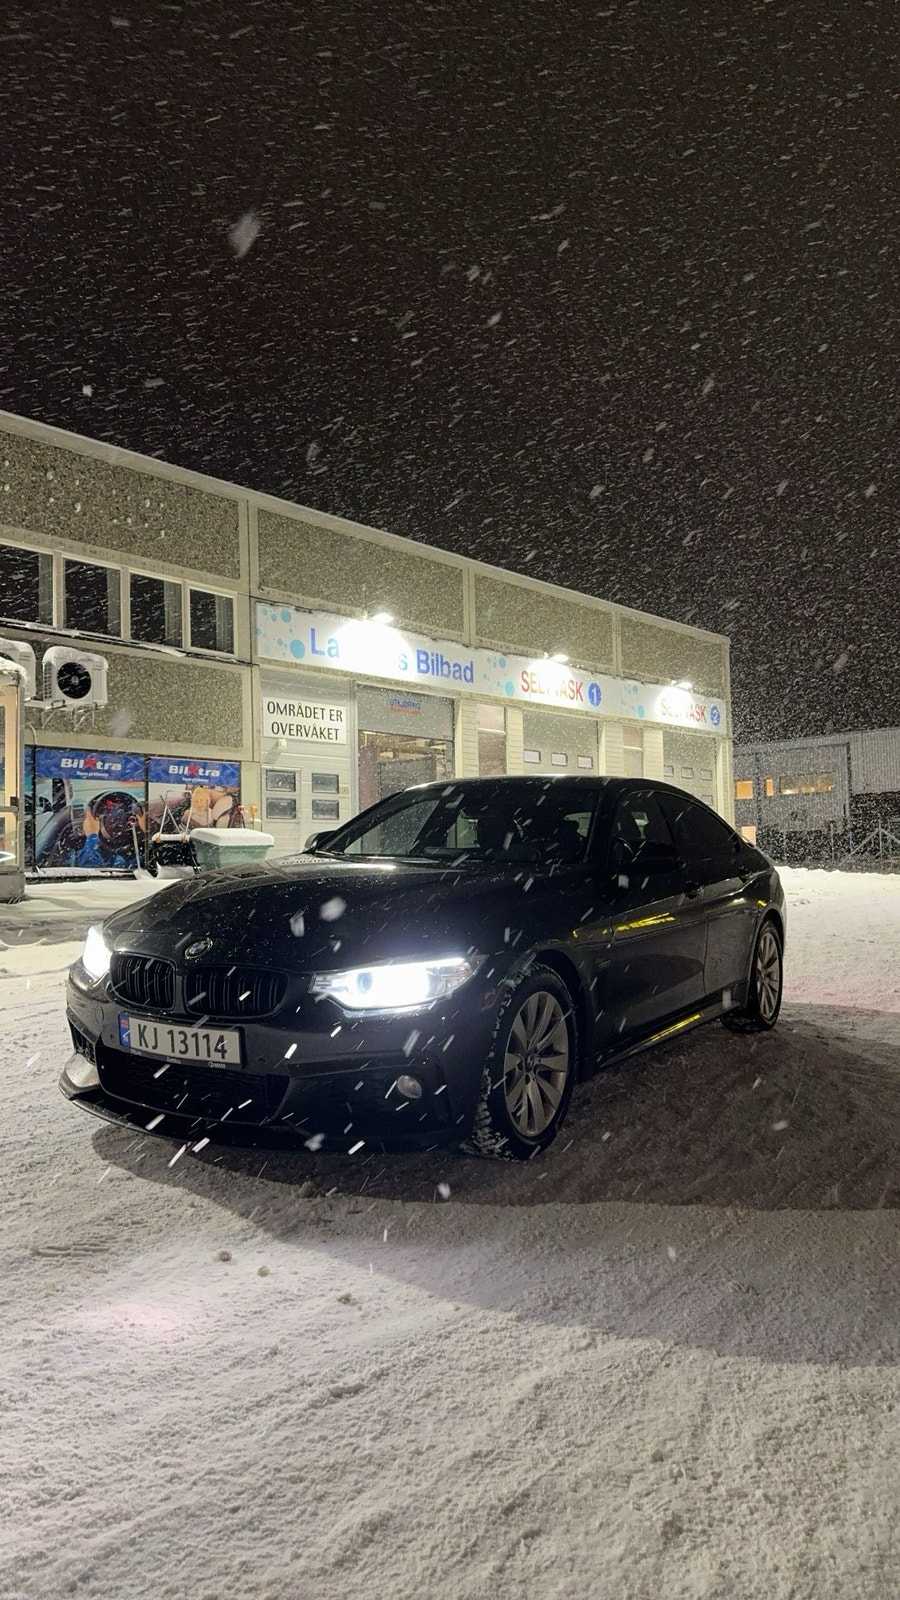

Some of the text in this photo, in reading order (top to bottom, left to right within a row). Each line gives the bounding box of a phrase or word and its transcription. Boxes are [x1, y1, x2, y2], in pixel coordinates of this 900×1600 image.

[416, 648, 474, 684] Bilbad
[267, 700, 343, 722] OMRÅDET ER
[271, 721, 340, 741] OVERVÅKET
[138, 1023, 227, 1059] KJ 13114
